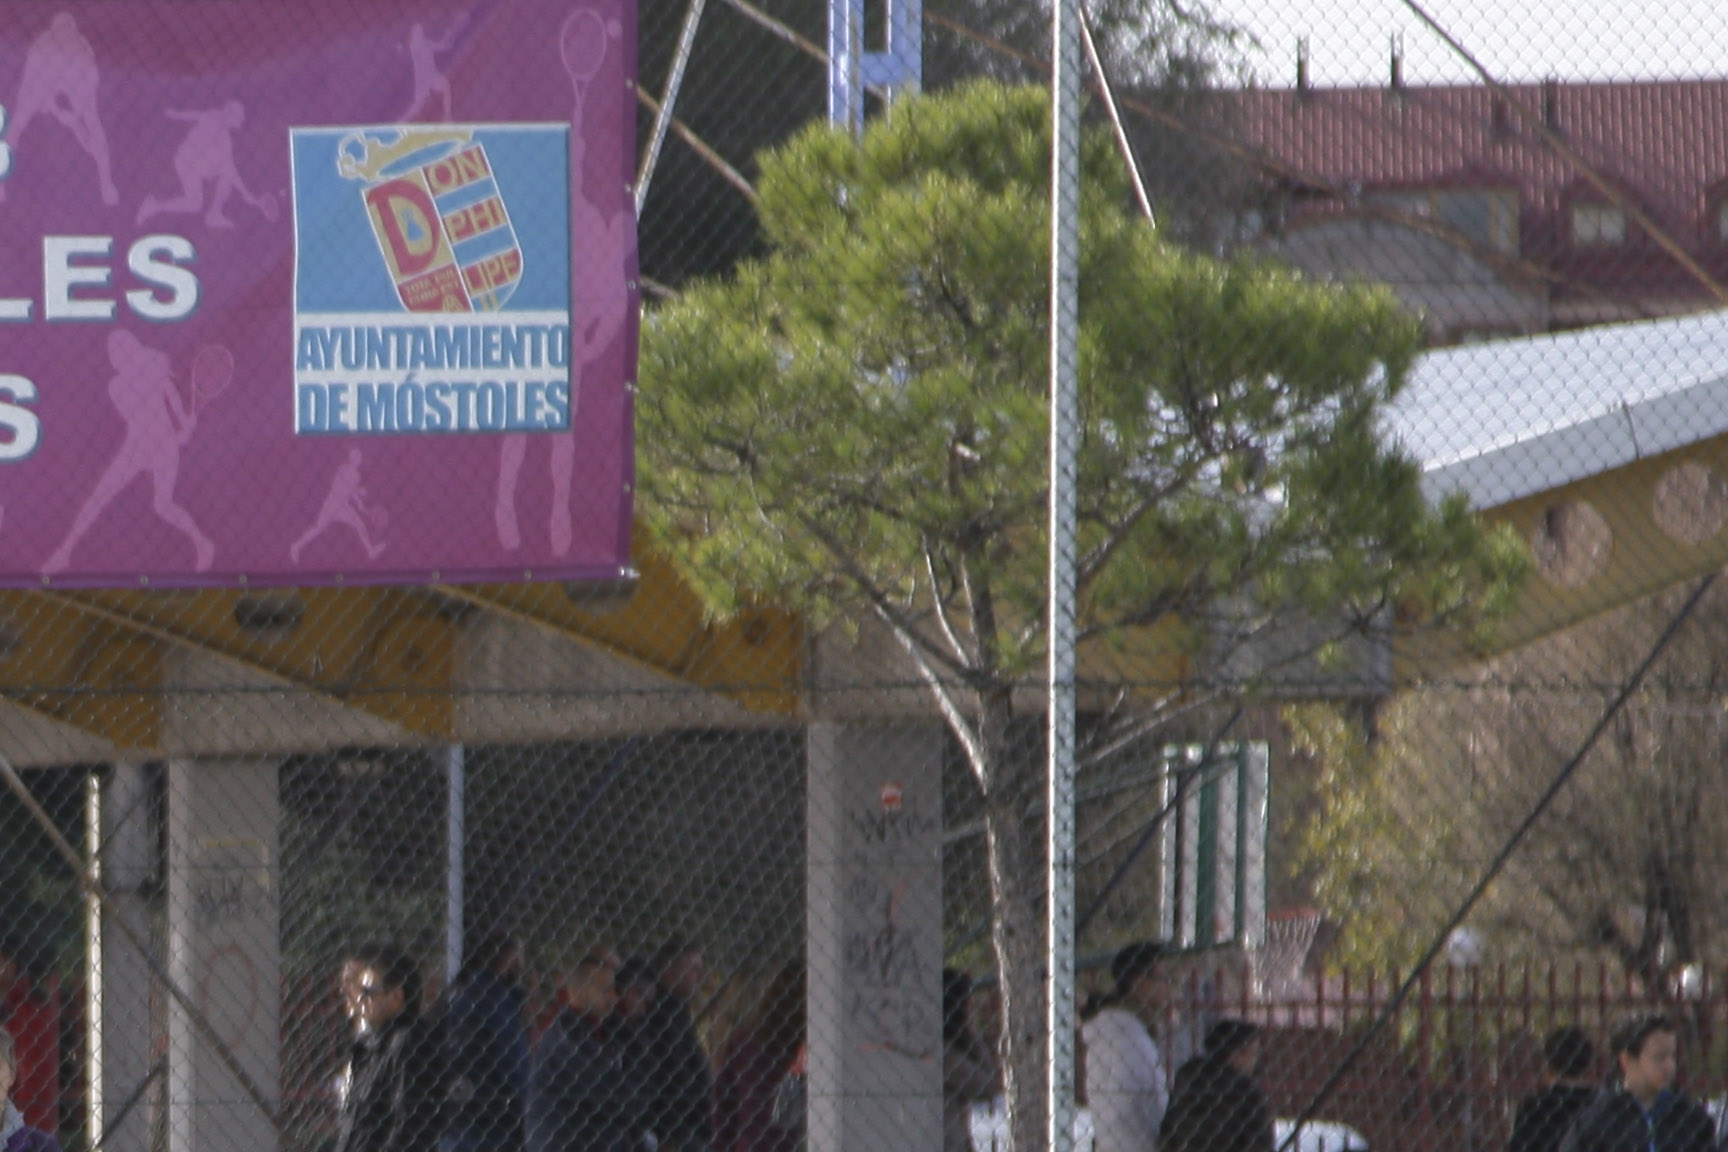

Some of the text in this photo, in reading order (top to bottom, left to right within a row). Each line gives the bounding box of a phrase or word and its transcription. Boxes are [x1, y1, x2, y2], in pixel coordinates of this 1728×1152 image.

[297, 325, 568, 370] AYUNTAMIENTO
[298, 372, 568, 431] DE MÓSTOLES
